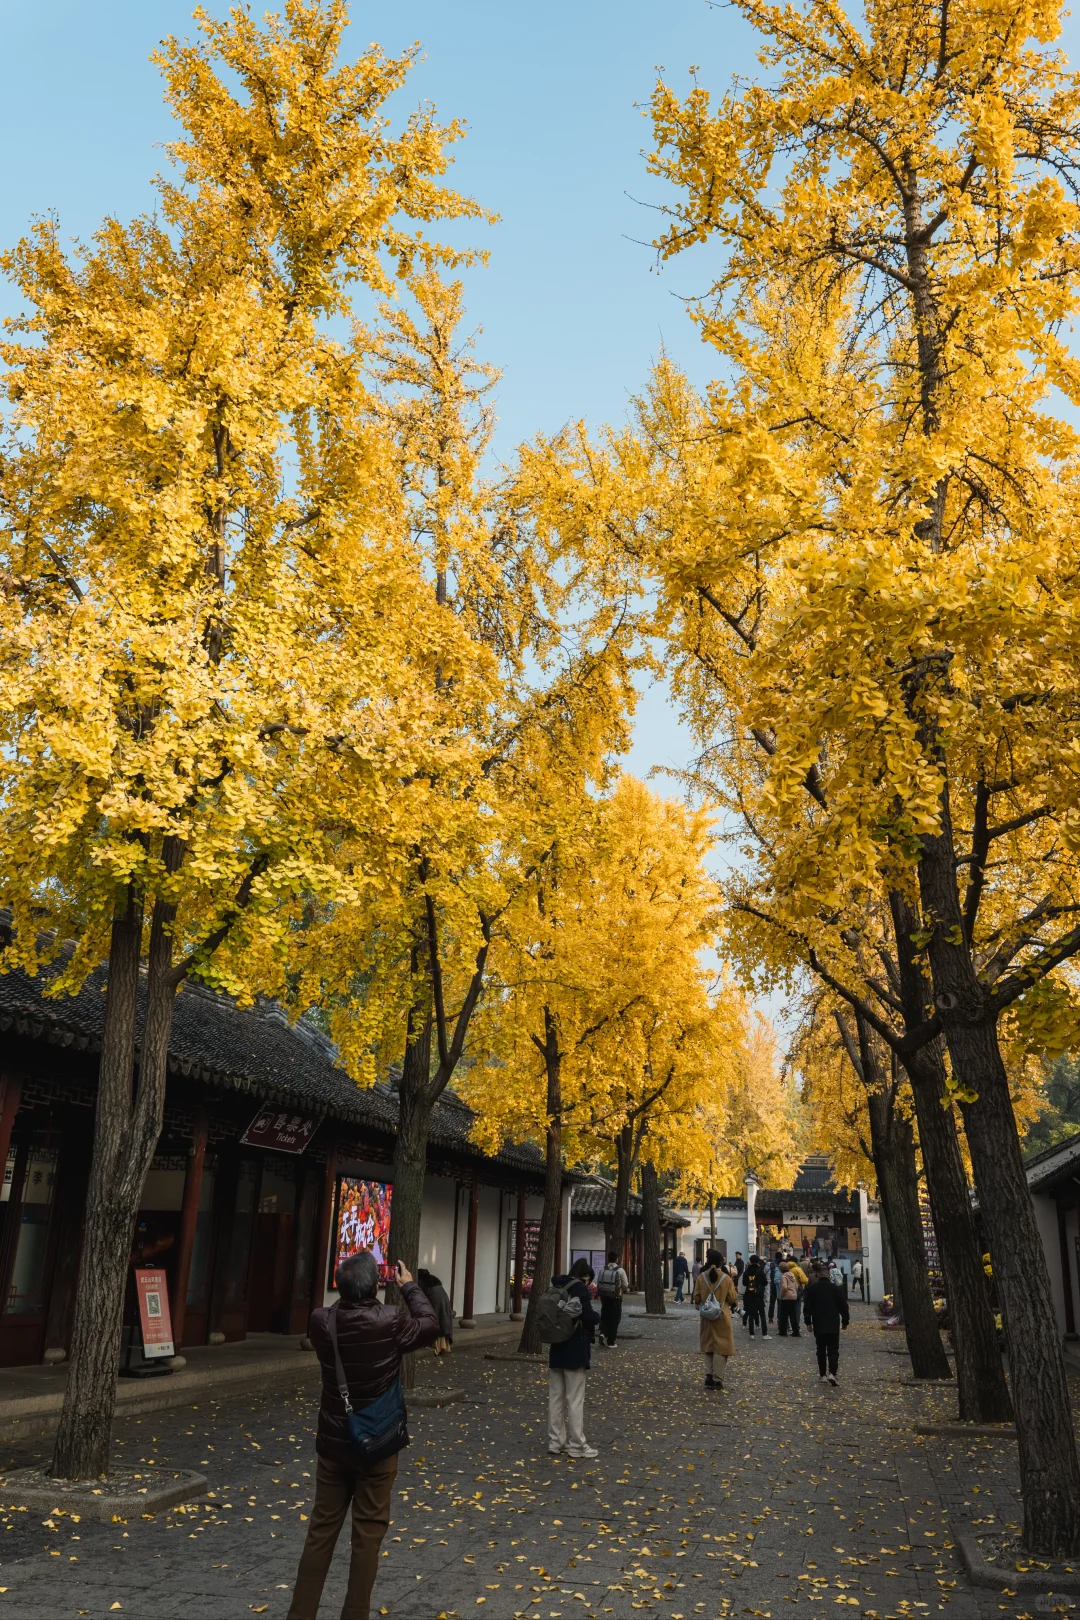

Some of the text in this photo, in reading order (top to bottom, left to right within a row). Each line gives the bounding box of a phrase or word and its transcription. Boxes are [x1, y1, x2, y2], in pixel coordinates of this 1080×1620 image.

[273, 1113, 313, 1136] 售票处
[275, 1132, 297, 1144] Tickets
